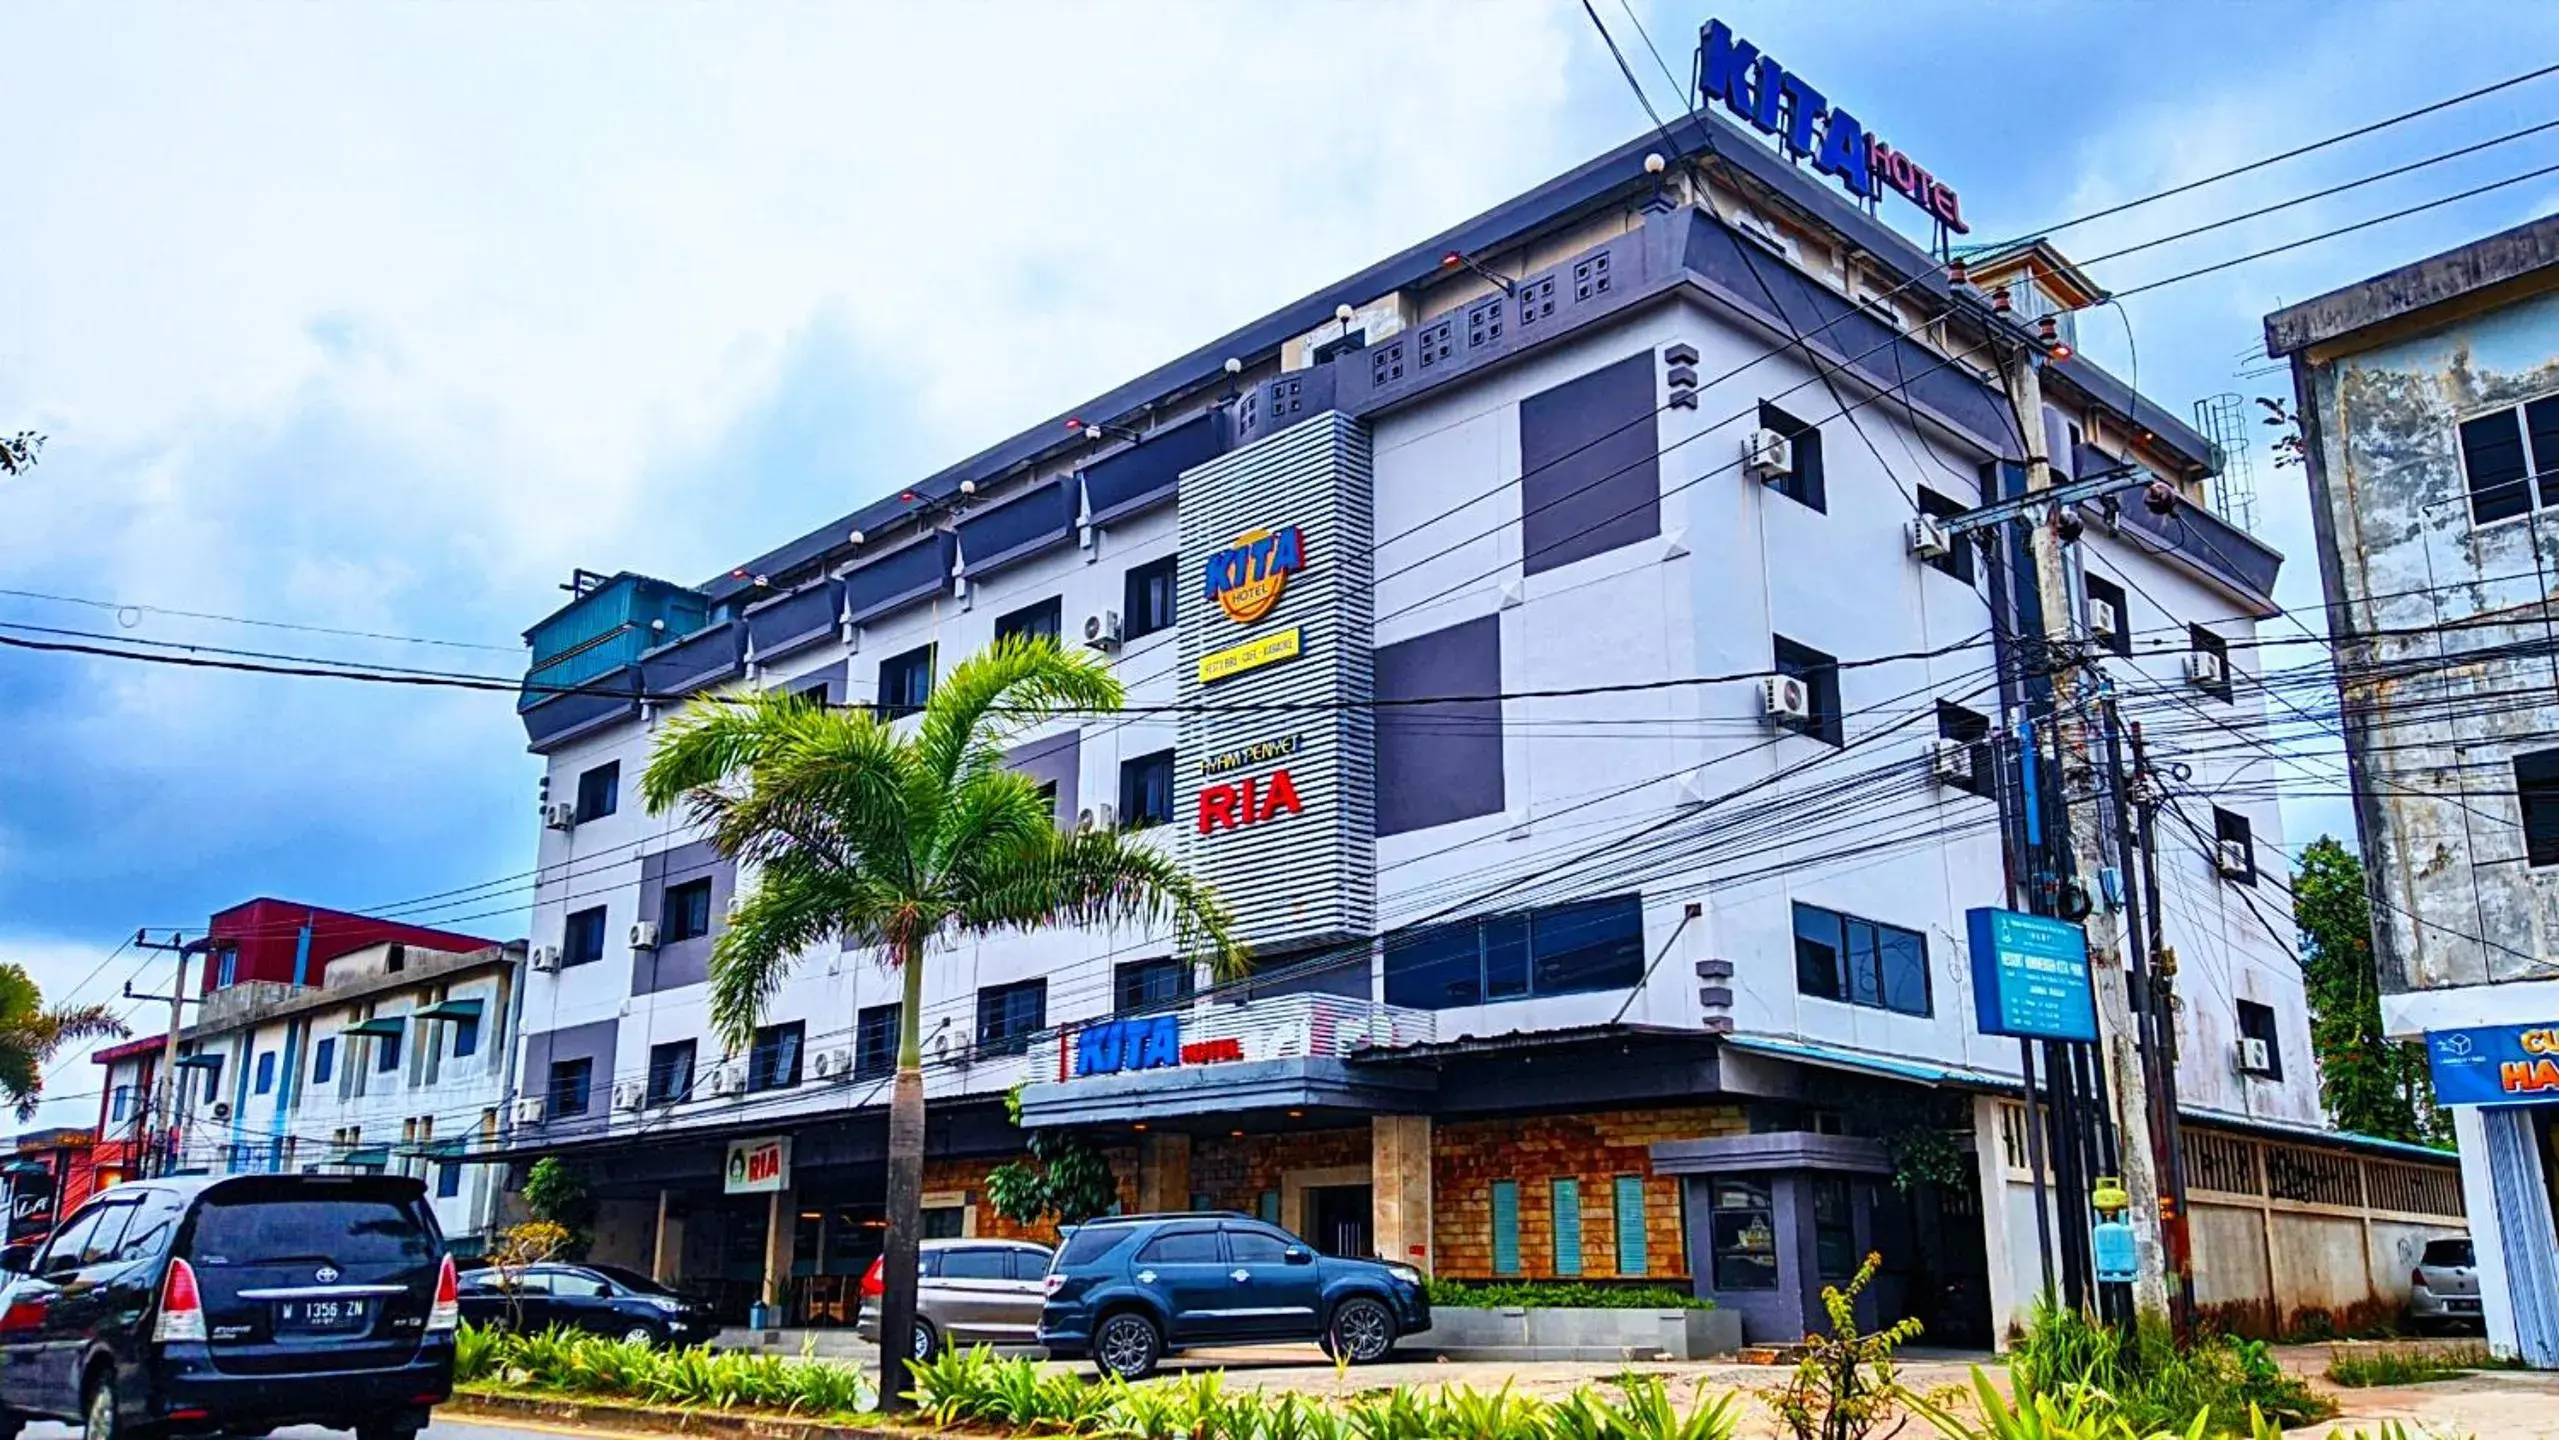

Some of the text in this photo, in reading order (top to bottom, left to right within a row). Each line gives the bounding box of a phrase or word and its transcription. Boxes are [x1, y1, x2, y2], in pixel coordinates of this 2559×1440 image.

[1700, 18, 1970, 235] KITA HOTEL
[1204, 526, 1304, 600] KITA
[1232, 583, 1269, 604] HOTEL
[1198, 769, 1303, 834] RIA
[1076, 1014, 1180, 1076] KITA
[2501, 1059, 2559, 1093] HA
[748, 1147, 779, 1183] RIA
[282, 1300, 364, 1319] W 1356 ZN
